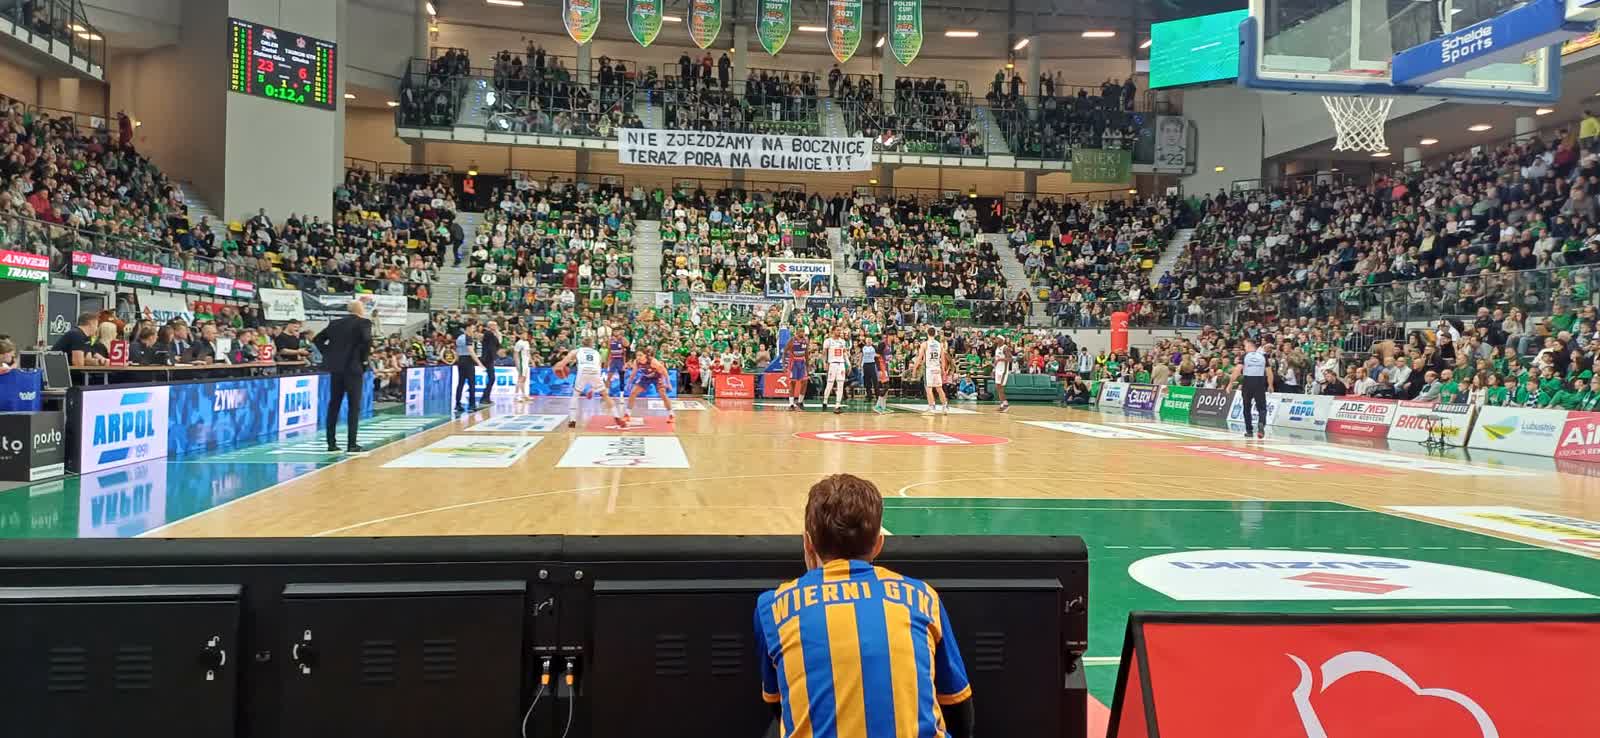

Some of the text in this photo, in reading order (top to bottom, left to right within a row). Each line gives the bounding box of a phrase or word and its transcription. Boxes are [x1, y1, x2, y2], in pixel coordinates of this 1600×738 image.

[1441, 24, 1494, 51] Schelde
[1441, 37, 1494, 64] Sports
[257, 58, 274, 73] 23
[298, 67, 308, 79] 6
[281, 79, 287, 88] 1
[627, 131, 658, 147] NIE
[762, 137, 783, 151] NA
[792, 138, 865, 157] BOCZNICĘ
[628, 149, 677, 165] TERAZ
[685, 151, 722, 167] PORA
[730, 152, 752, 168] NA
[788, 265, 826, 273] SUZUKI
[111, 343, 123, 360] 5
[1289, 406, 1315, 416] ARPOL
[93, 408, 155, 446] ARPOL
[1168, 560, 1411, 570] SUZUKI
[771, 581, 872, 625] WIERNI
